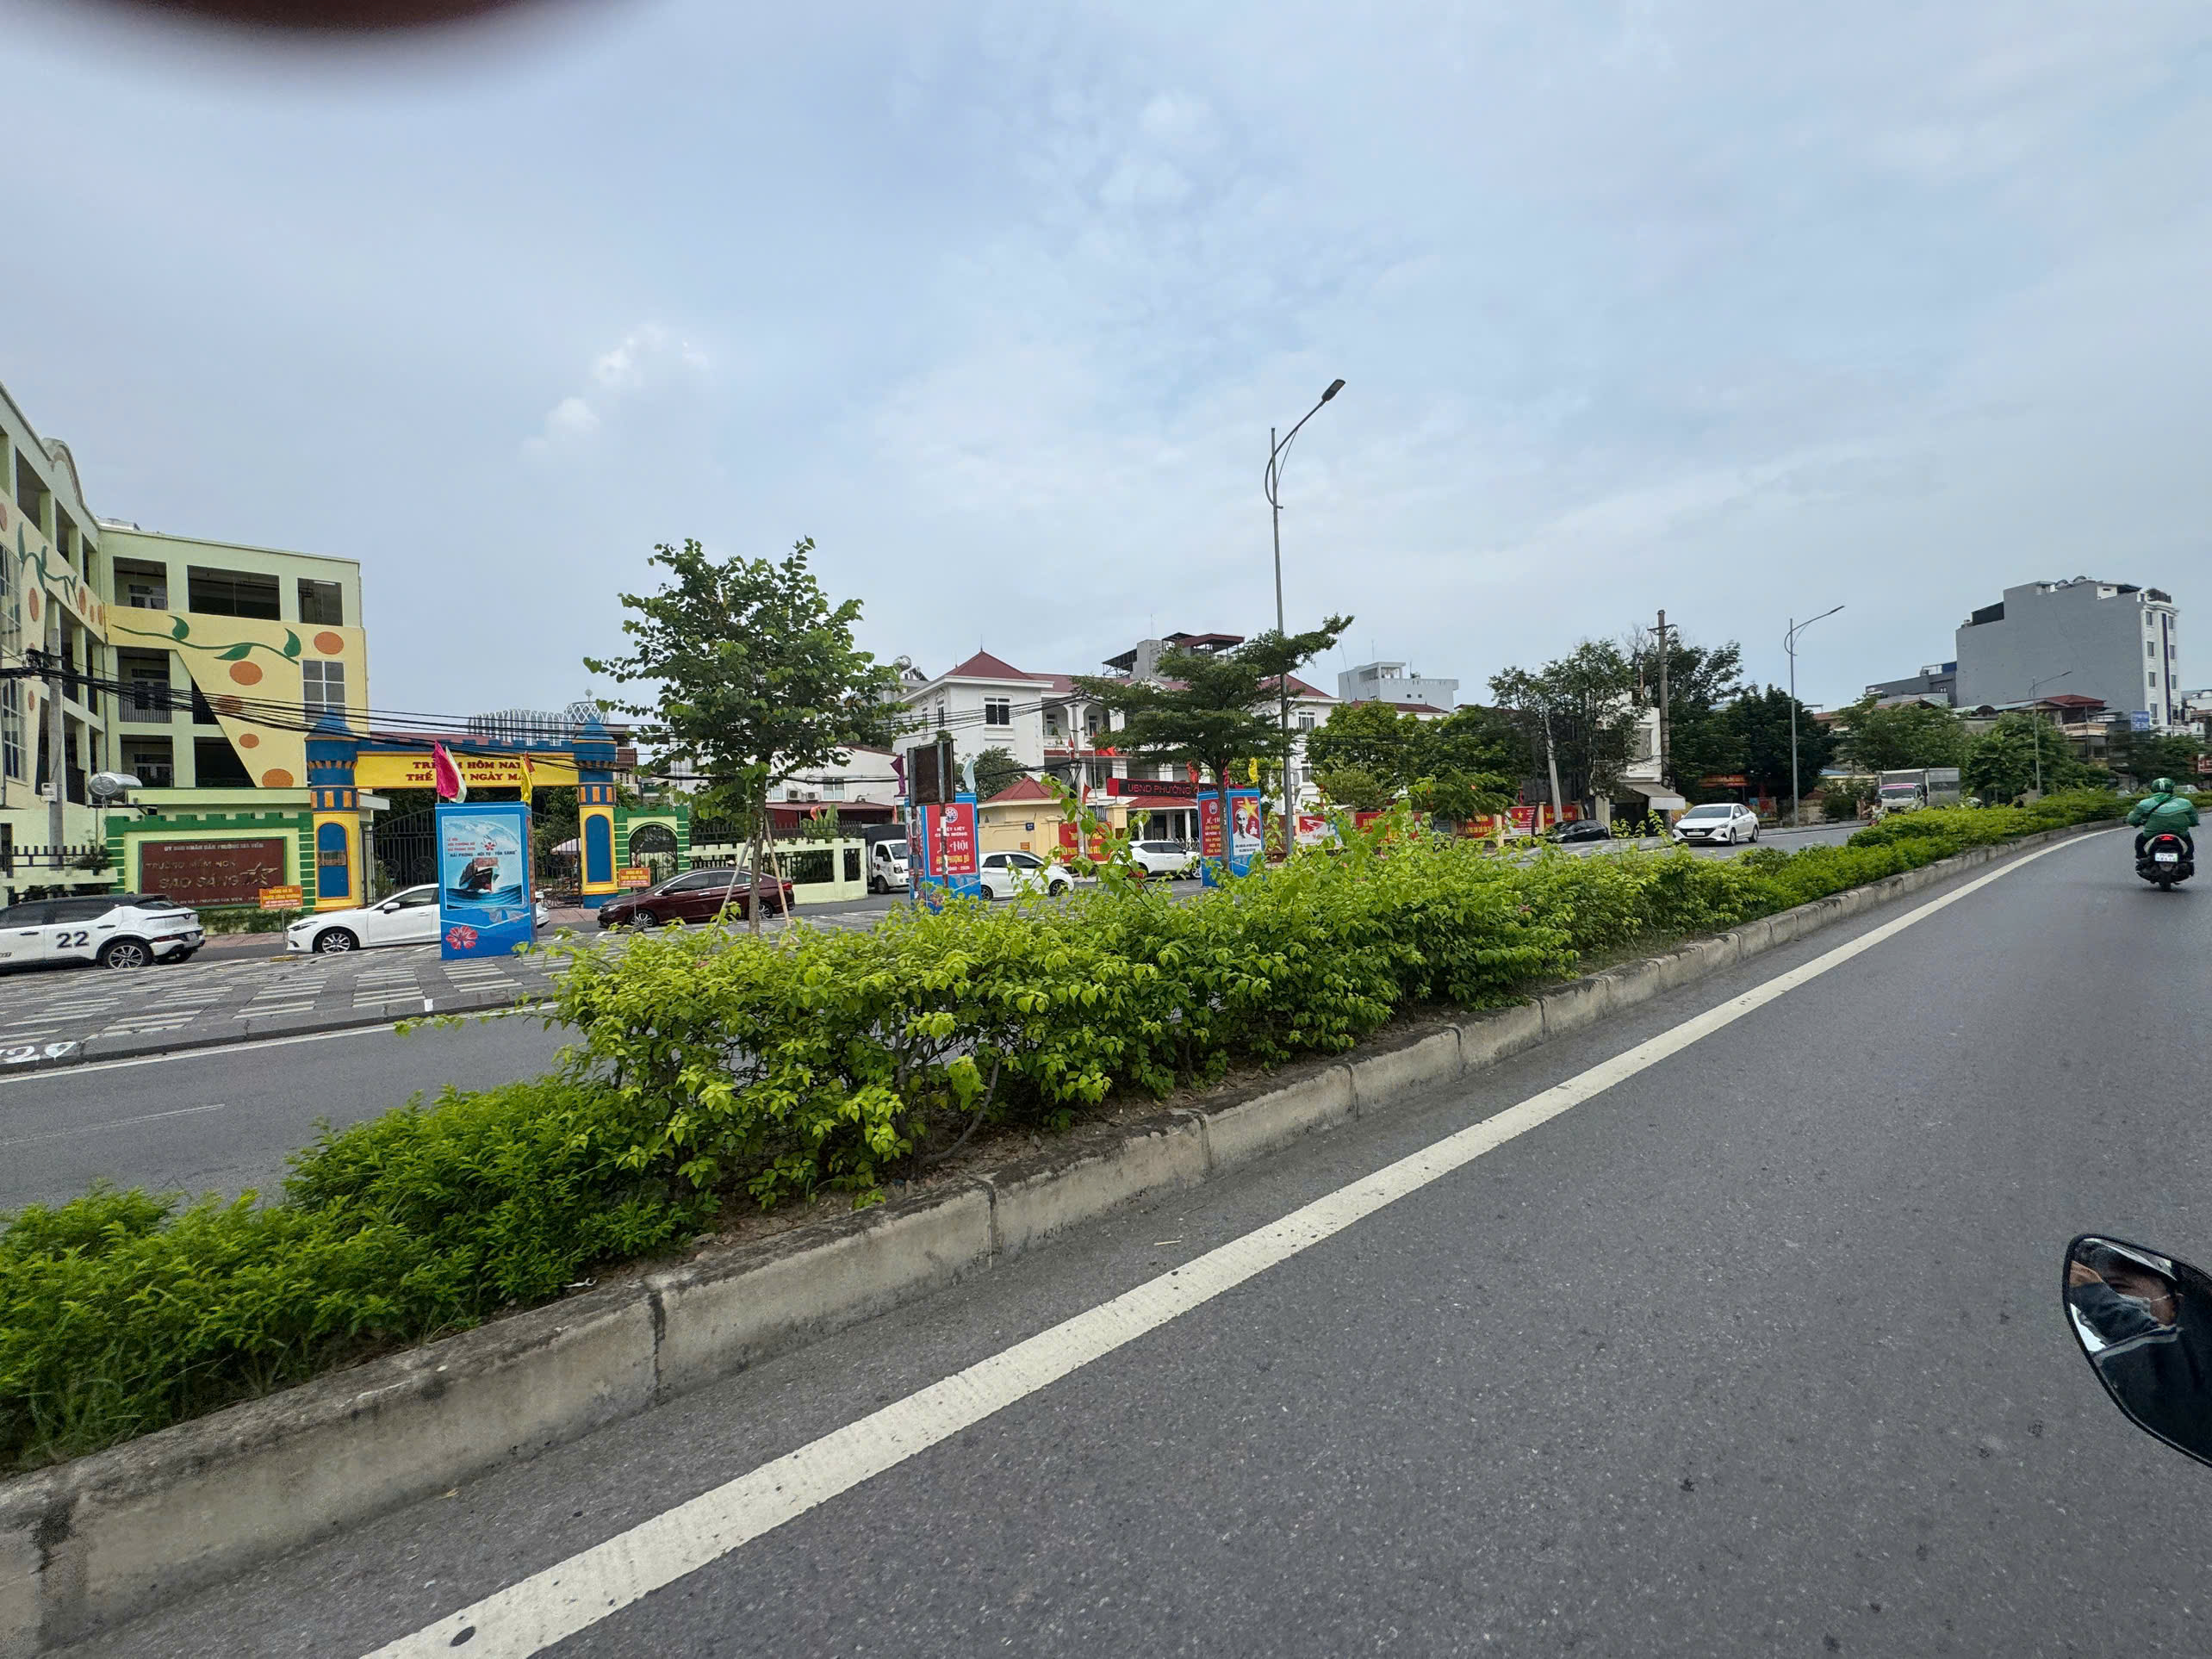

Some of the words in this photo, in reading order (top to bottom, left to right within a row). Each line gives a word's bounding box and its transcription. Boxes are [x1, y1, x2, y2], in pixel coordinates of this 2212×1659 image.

[467, 760, 494, 768] HÔM
[406, 770, 433, 780] THẾ
[469, 771, 503, 780] NGÀY
[1128, 784, 1152, 792] UBND
[158, 877, 191, 889] SAO
[56, 931, 90, 949] 22
